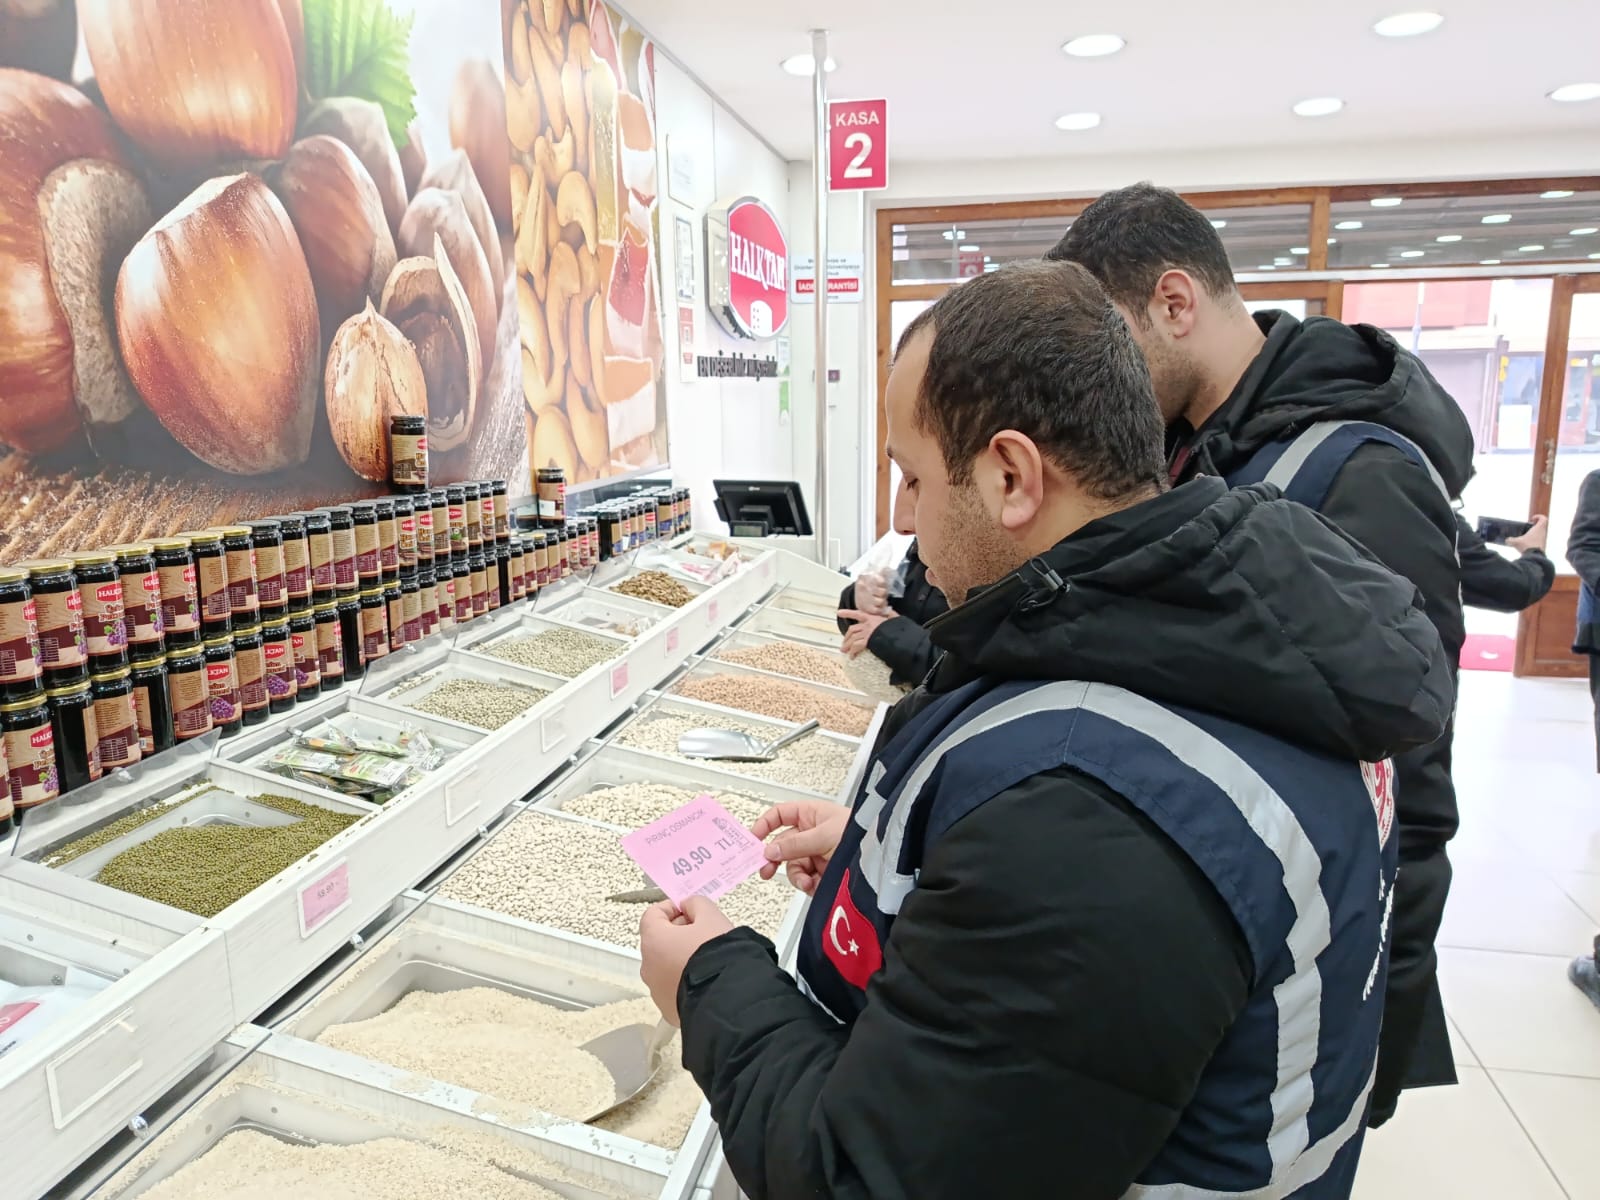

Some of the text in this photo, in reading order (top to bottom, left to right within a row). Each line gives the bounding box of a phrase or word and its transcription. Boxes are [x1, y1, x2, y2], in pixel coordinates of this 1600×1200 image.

[835, 110, 880, 127] KASA
[843, 132, 873, 179] 2
[672, 846, 712, 876] 49,90
